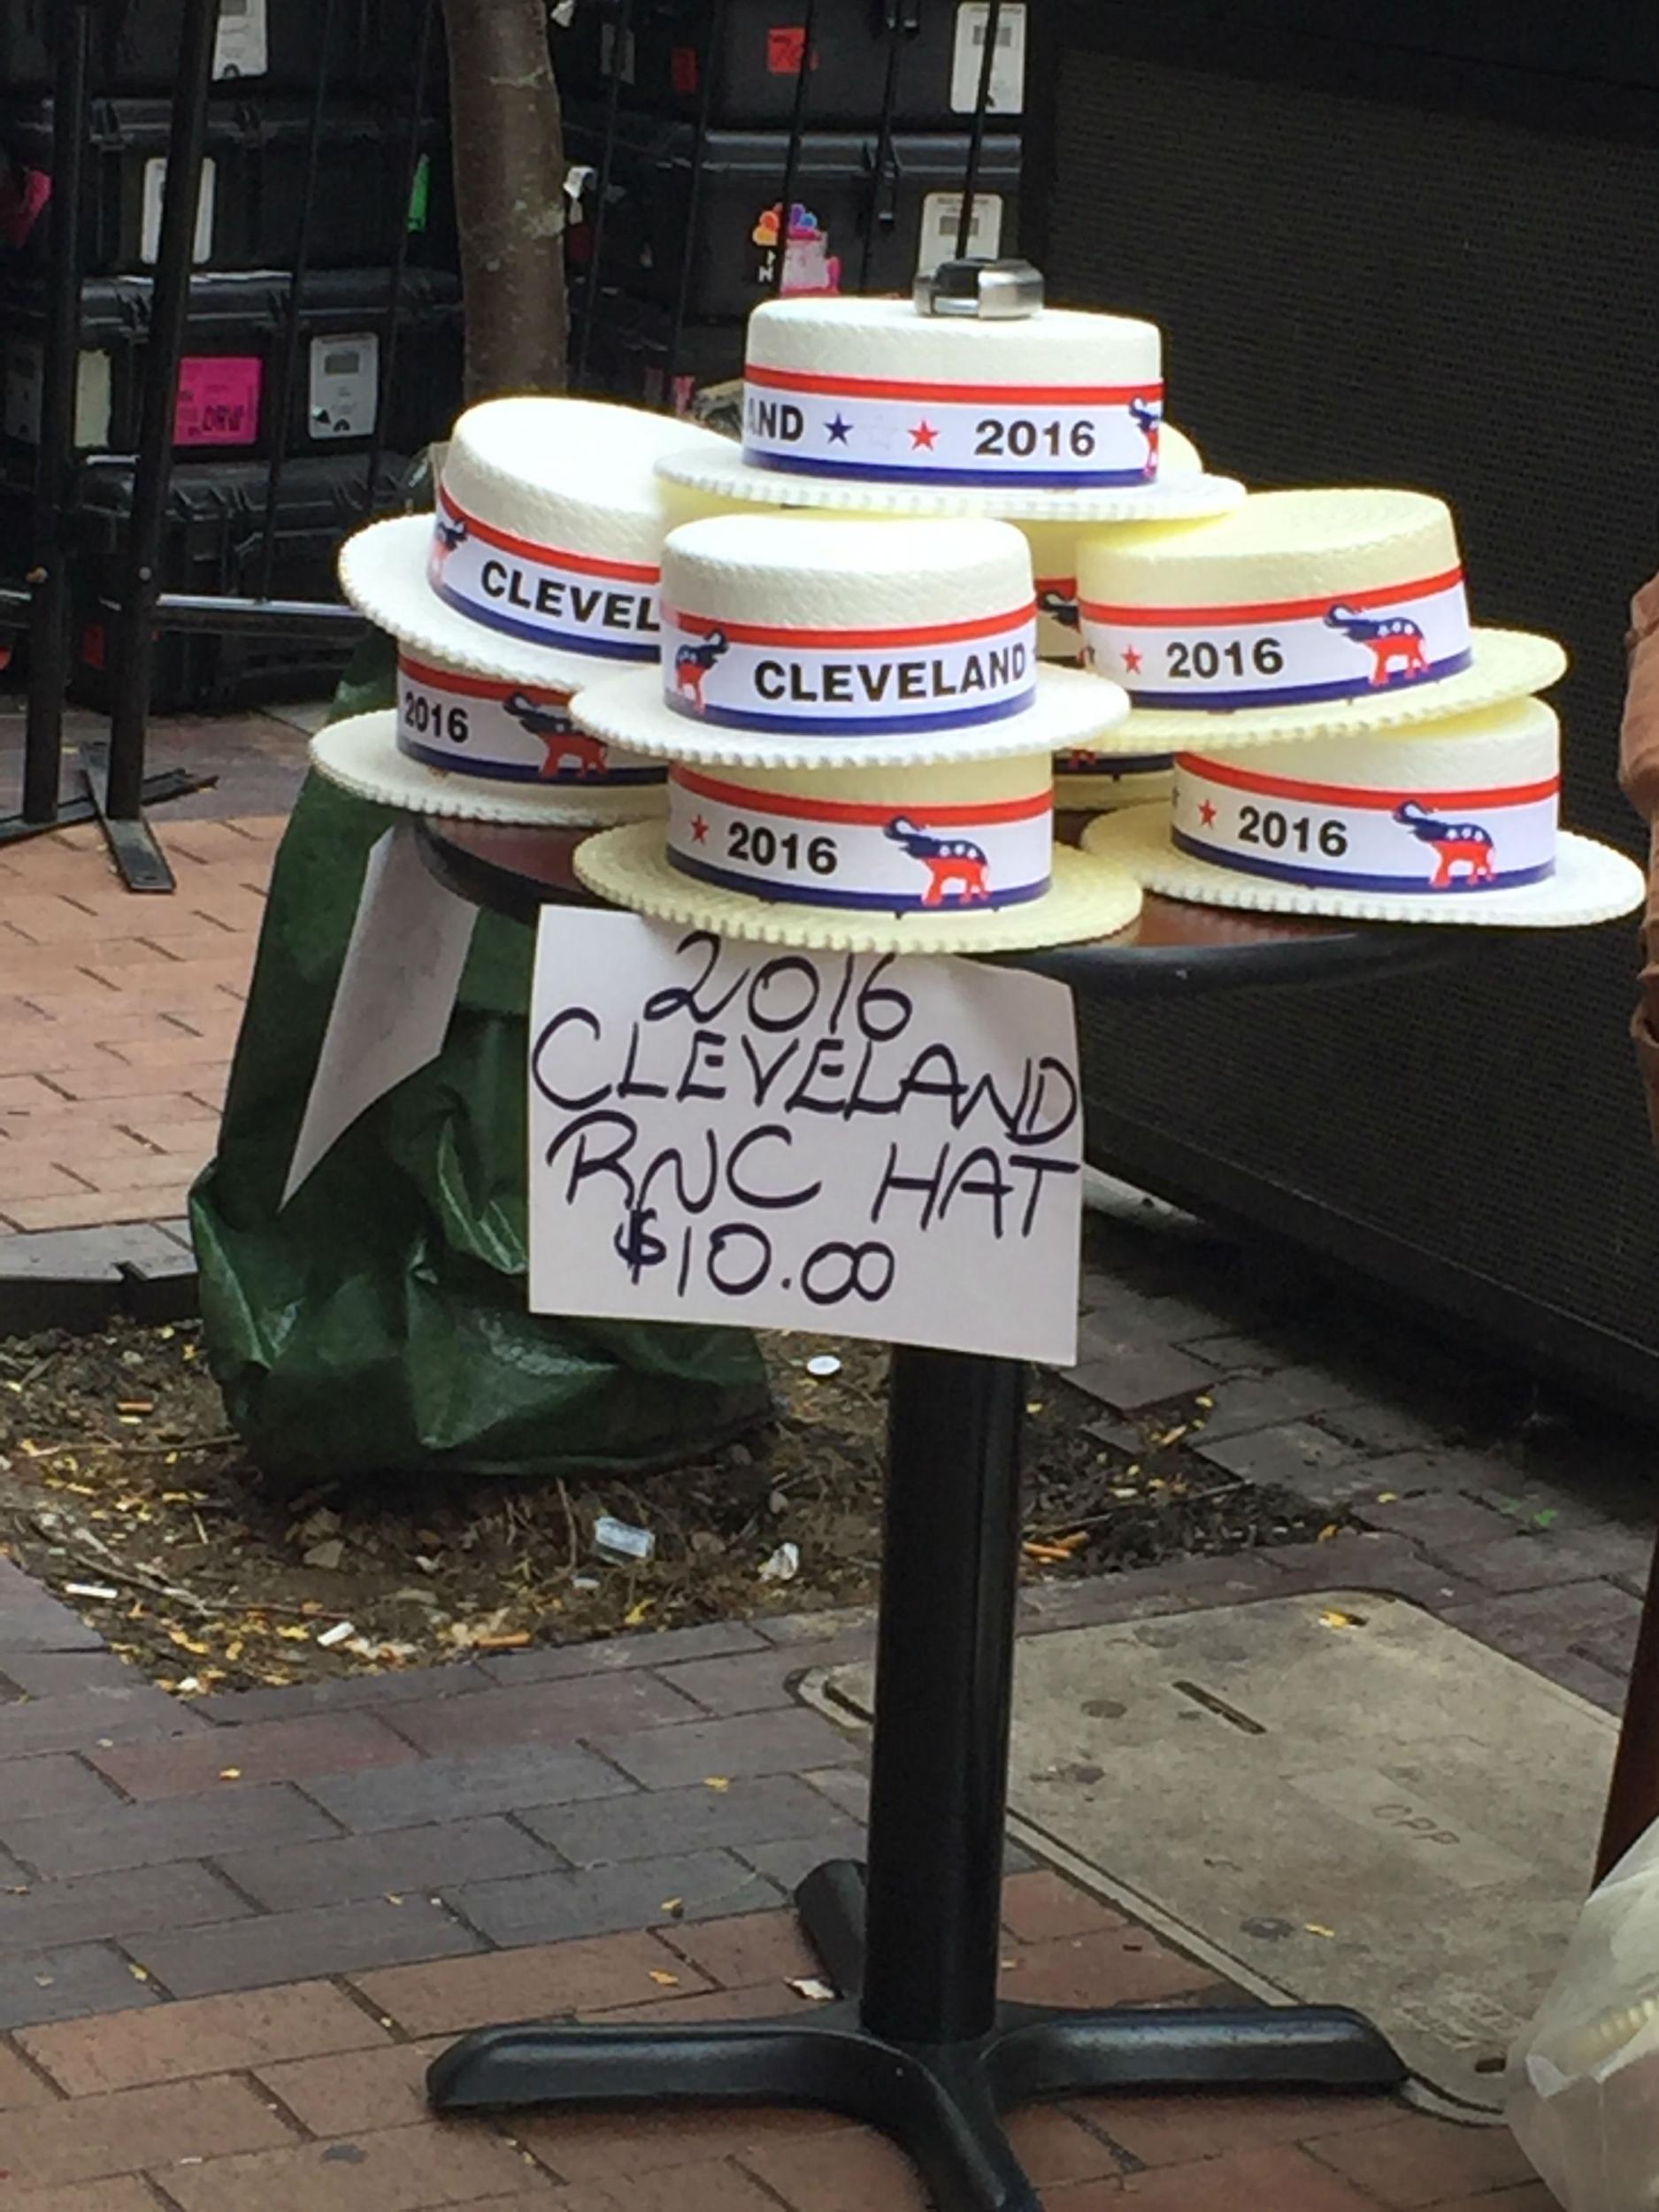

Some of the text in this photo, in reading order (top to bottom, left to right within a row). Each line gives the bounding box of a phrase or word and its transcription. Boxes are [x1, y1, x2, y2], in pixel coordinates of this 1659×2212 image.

[974, 419, 1096, 457] 2016
[480, 559, 660, 632] CLEVEL
[753, 642, 1026, 703] CLEVELAND
[1165, 636, 1284, 680] 2016
[404, 691, 469, 743] 2016
[727, 821, 838, 876] 2016
[1238, 805, 1348, 857] 2016
[644, 930, 914, 1042] 2016
[530, 1006, 1079, 1146] CLEVELAND
[545, 1109, 1080, 1239] RNC HAT
[614, 1207, 895, 1305] $10.00
